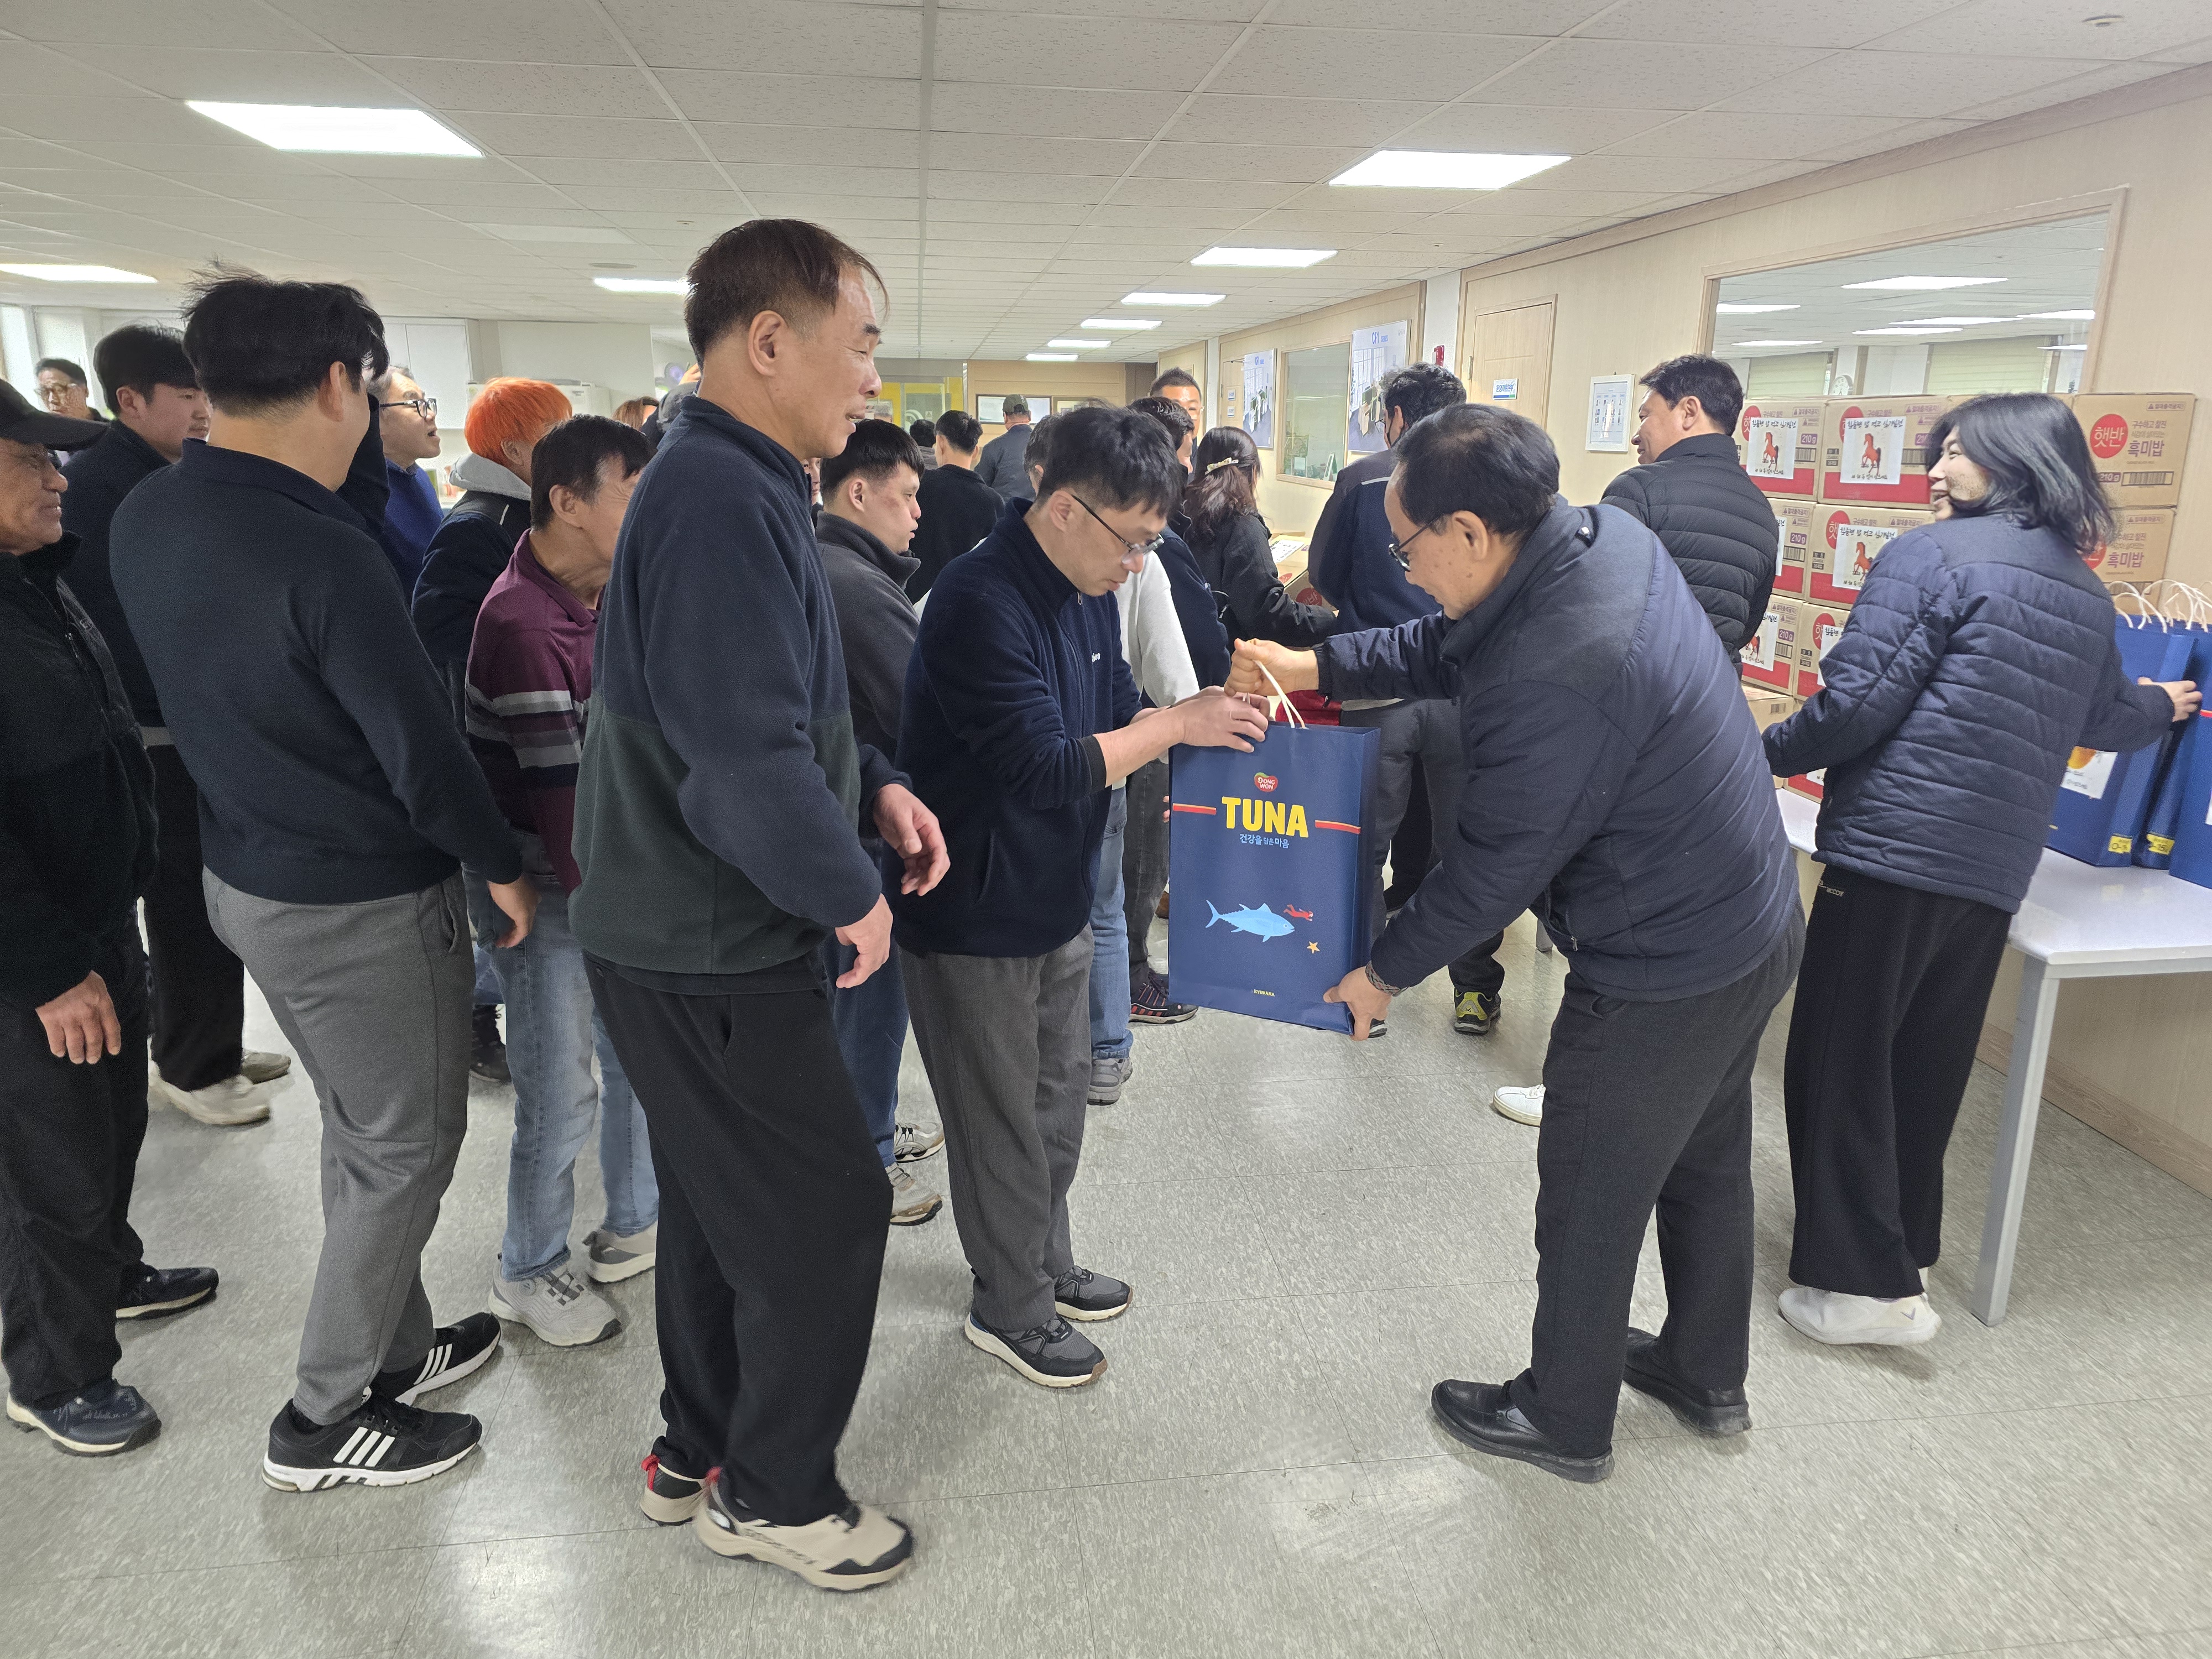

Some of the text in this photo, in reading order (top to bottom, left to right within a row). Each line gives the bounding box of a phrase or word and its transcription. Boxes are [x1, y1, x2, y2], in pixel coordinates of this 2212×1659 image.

[2132, 420, 2154, 429] 구수하고
[2094, 426, 2124, 447] 햇반
[2127, 440, 2164, 457] 흑미밥
[2107, 552, 2144, 568] 흑미밥
[1258, 776, 1275, 785] DONG
[1222, 796, 1308, 838] TUNA
[1239, 833, 1289, 849] 건강을 담은 마음
